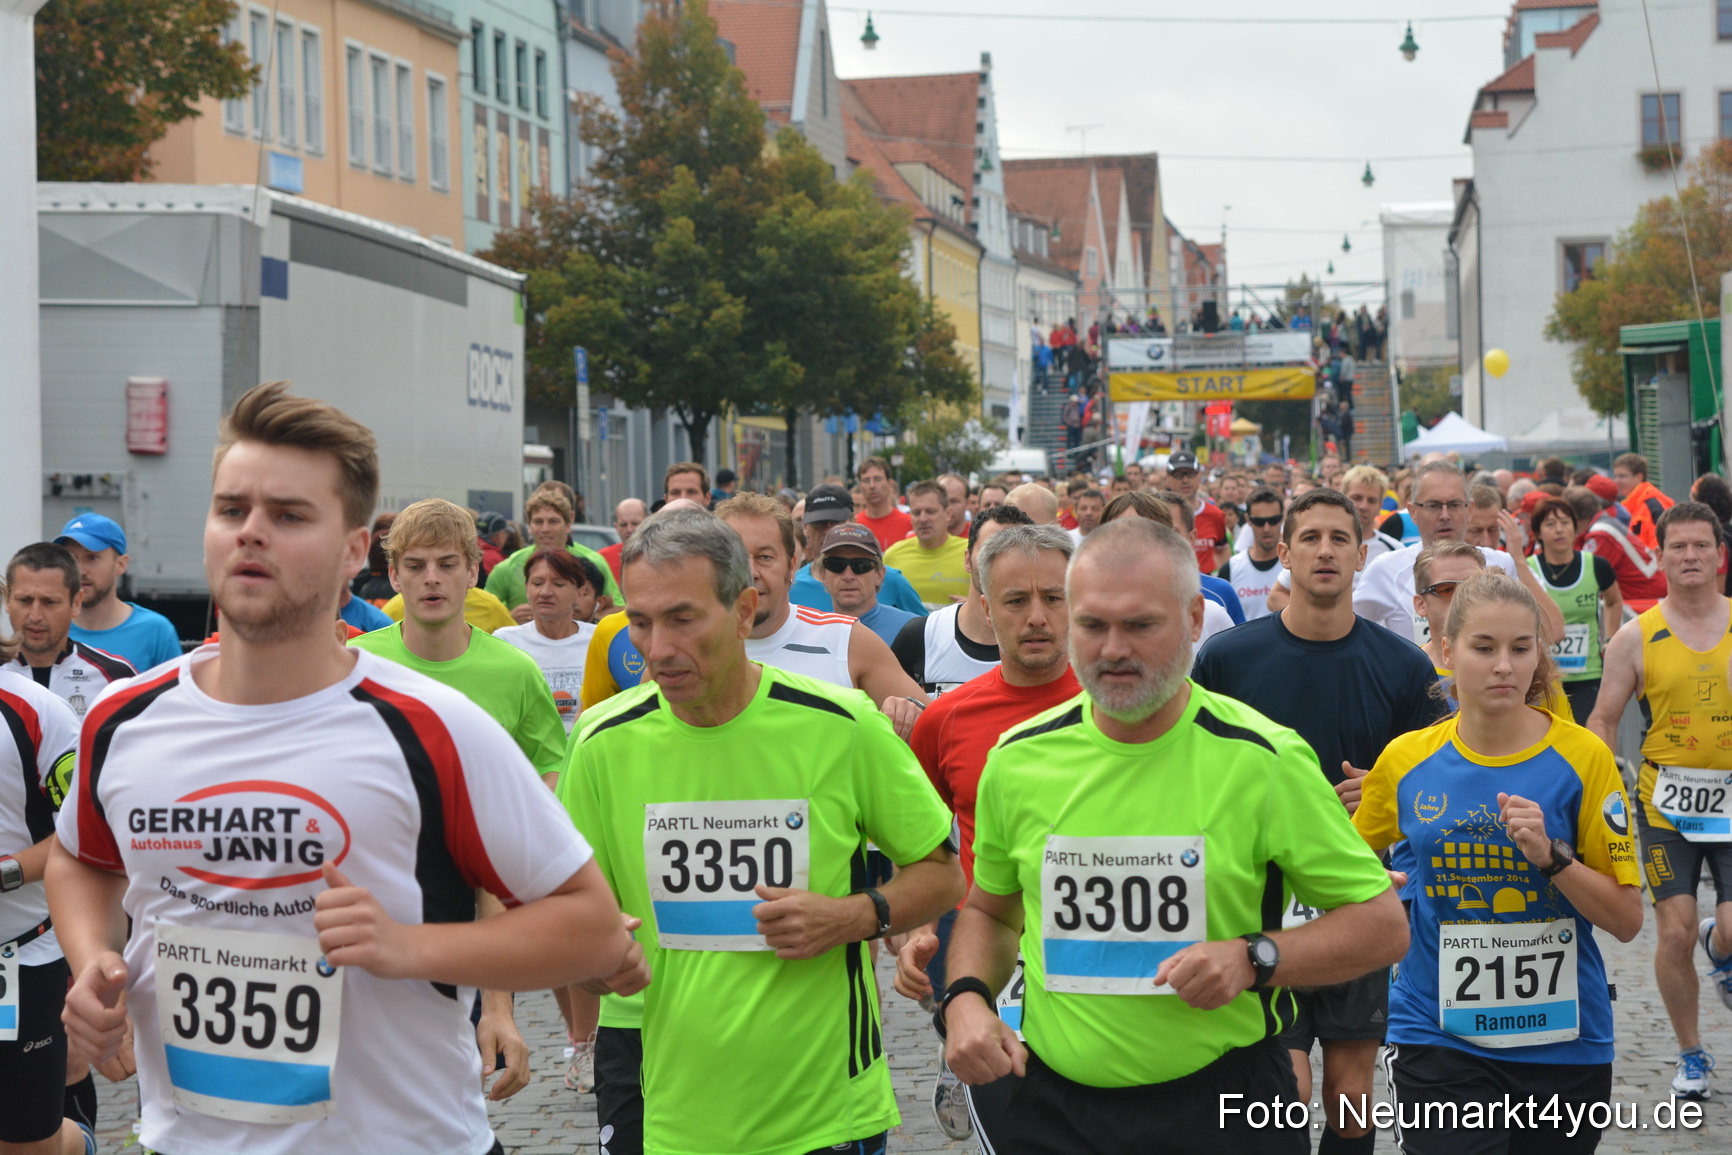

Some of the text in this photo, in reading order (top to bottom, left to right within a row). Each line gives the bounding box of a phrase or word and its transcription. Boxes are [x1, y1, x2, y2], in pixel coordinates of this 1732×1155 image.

[467, 342, 514, 412] BOCK
[1176, 375, 1247, 393] START
[1659, 770, 1722, 784] PARTL Neumarkt
[1660, 784, 1726, 814] 2802
[128, 808, 321, 833] GERHART &
[647, 816, 779, 831] PARTL Neumarkt
[1675, 818, 1705, 832] Klaus
[131, 837, 203, 851] Autohaus
[661, 837, 793, 893] 3350
[1045, 850, 1173, 866] PARTL Neumarkt
[1652, 848, 1671, 877] Run!
[1435, 874, 1530, 884] 21.September 2014
[160, 876, 186, 900] Das
[190, 893, 268, 917] sportliche
[1054, 875, 1189, 932] 3308
[1443, 934, 1553, 949] PARTL Neumarkt
[157, 942, 307, 973] PARTL Neumarkt
[1454, 951, 1565, 1001] 2157
[172, 972, 321, 1053] 3359
[1475, 1013, 1547, 1031] Ramona
[34, 1036, 53, 1049] asics
